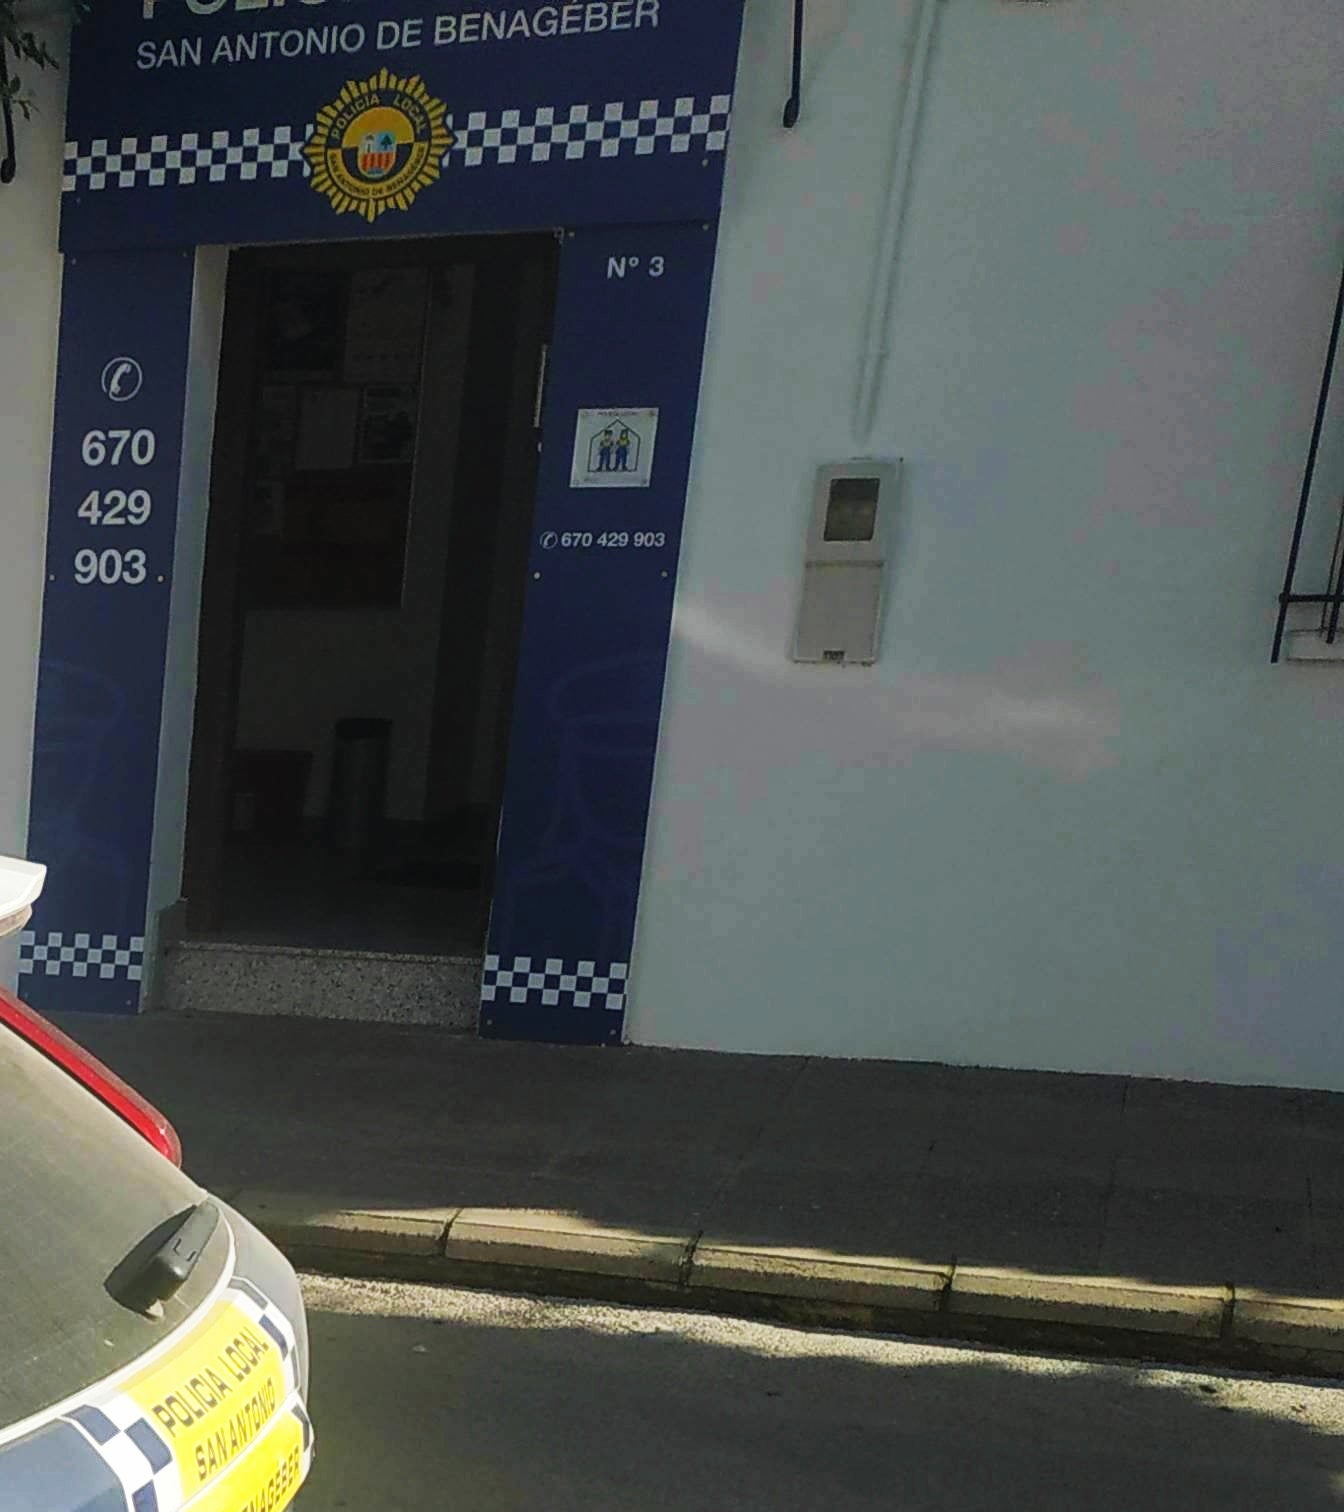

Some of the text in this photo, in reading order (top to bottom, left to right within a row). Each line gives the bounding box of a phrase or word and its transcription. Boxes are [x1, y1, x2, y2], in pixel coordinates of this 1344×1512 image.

[137, 0, 661, 70] SAN ANTONIO DE BENAGÉBER
[648, 255, 665, 277] 3
[81, 429, 156, 467] 670
[77, 488, 152, 526] 429
[561, 531, 666, 548] 670 429 903
[74, 548, 147, 585] 903
[151, 1325, 270, 1438] POLICIA LOCAL
[195, 1376, 277, 1483] SAN ANTONIO
